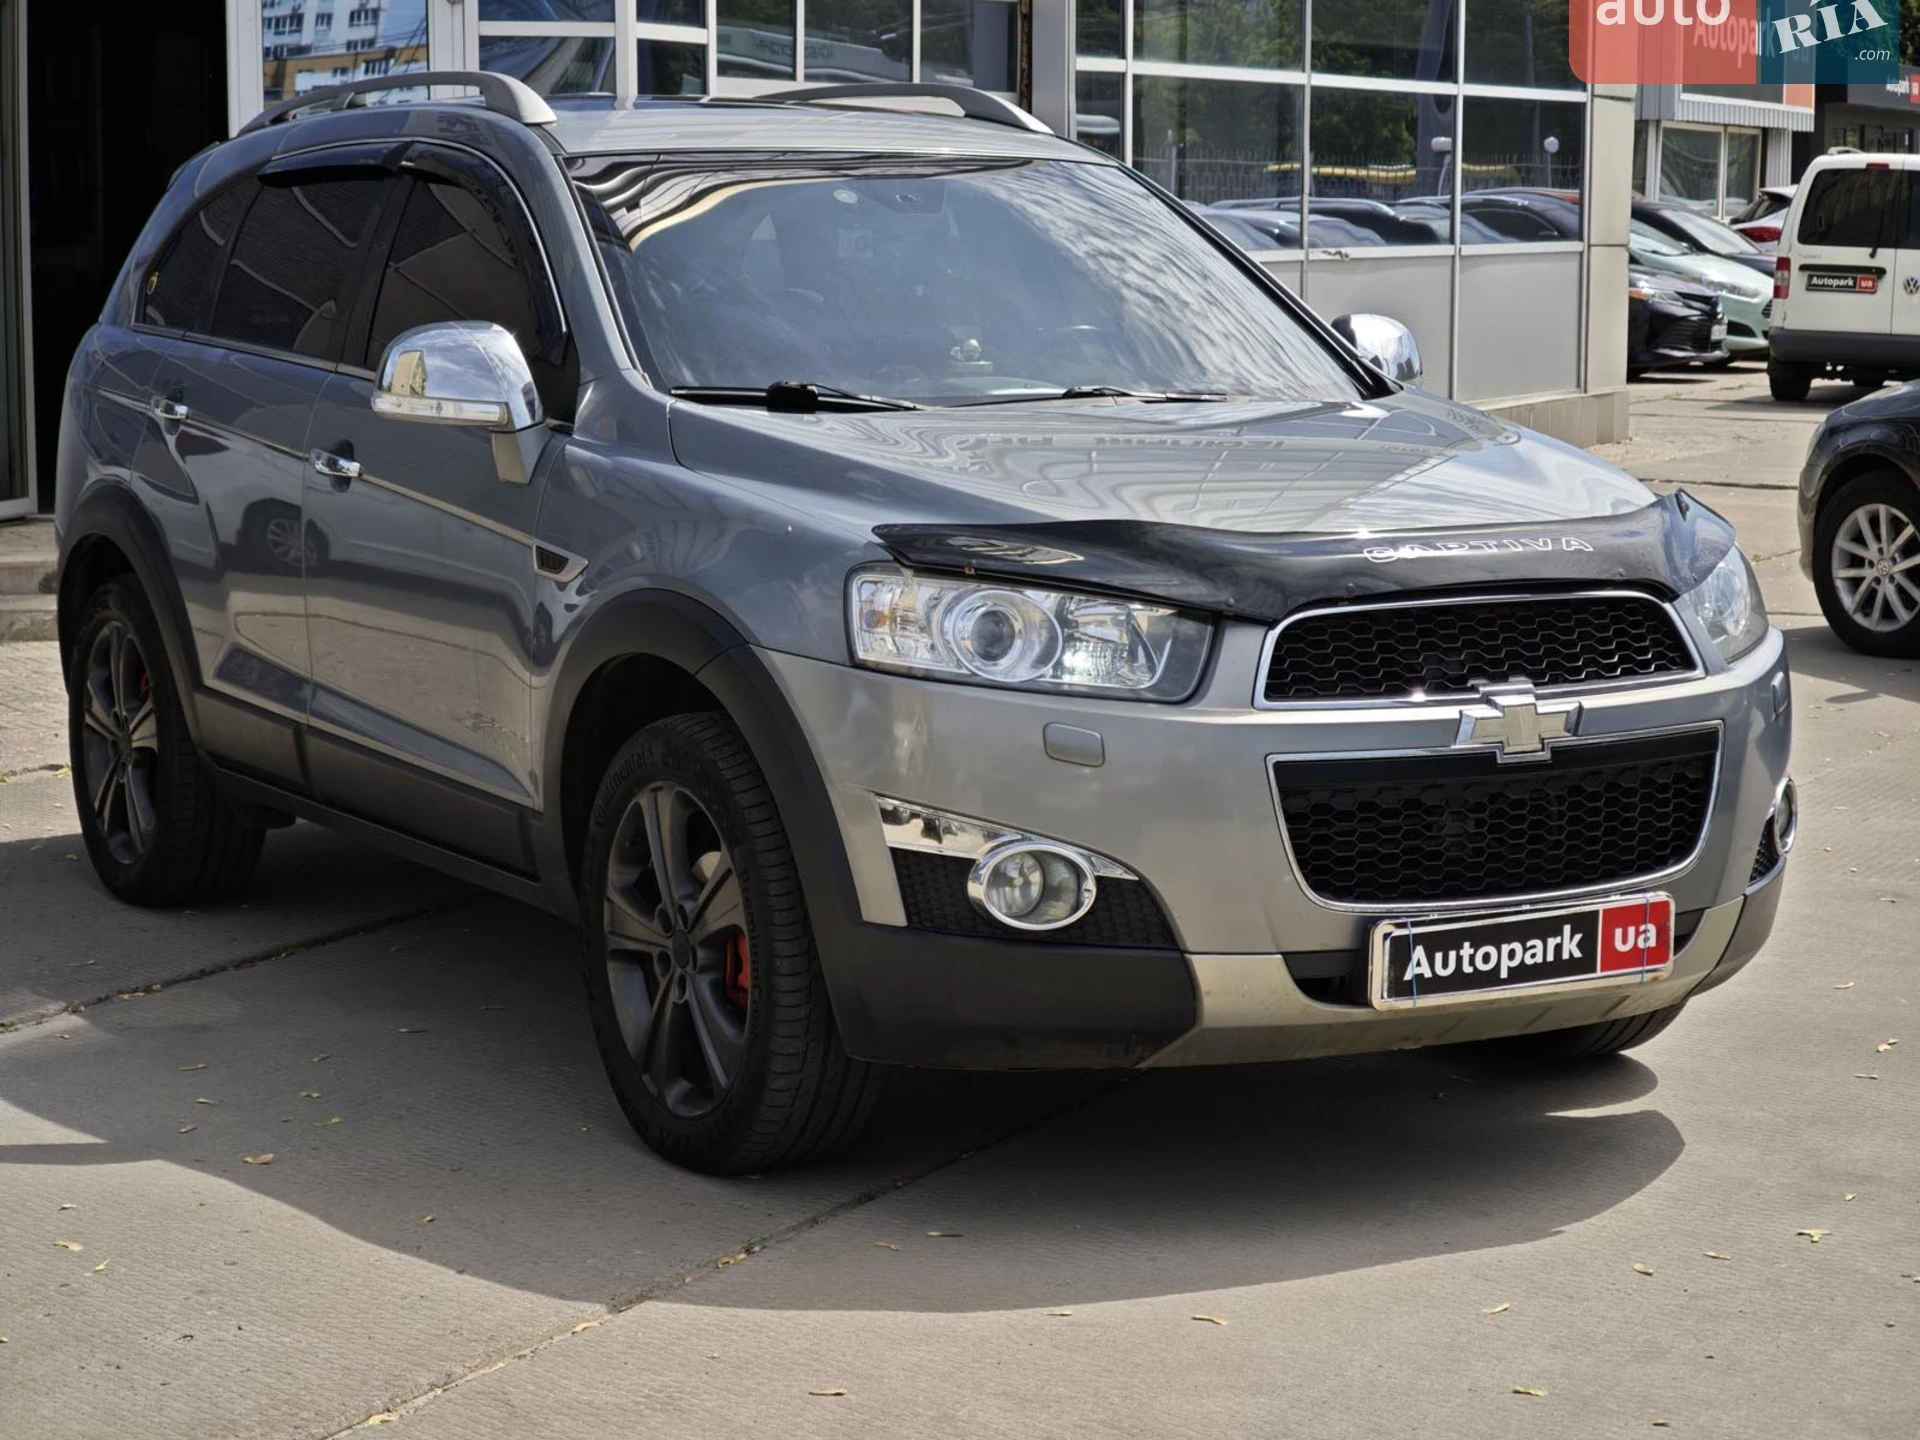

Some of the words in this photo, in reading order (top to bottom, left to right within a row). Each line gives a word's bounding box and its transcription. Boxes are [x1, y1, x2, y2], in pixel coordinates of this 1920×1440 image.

[1811, 276, 1854, 288] Autopark
[1860, 279, 1873, 288] ua
[1363, 537, 1594, 563] CAPTIVA
[1403, 924, 1583, 980] Autopark
[1613, 922, 1658, 952] ua
